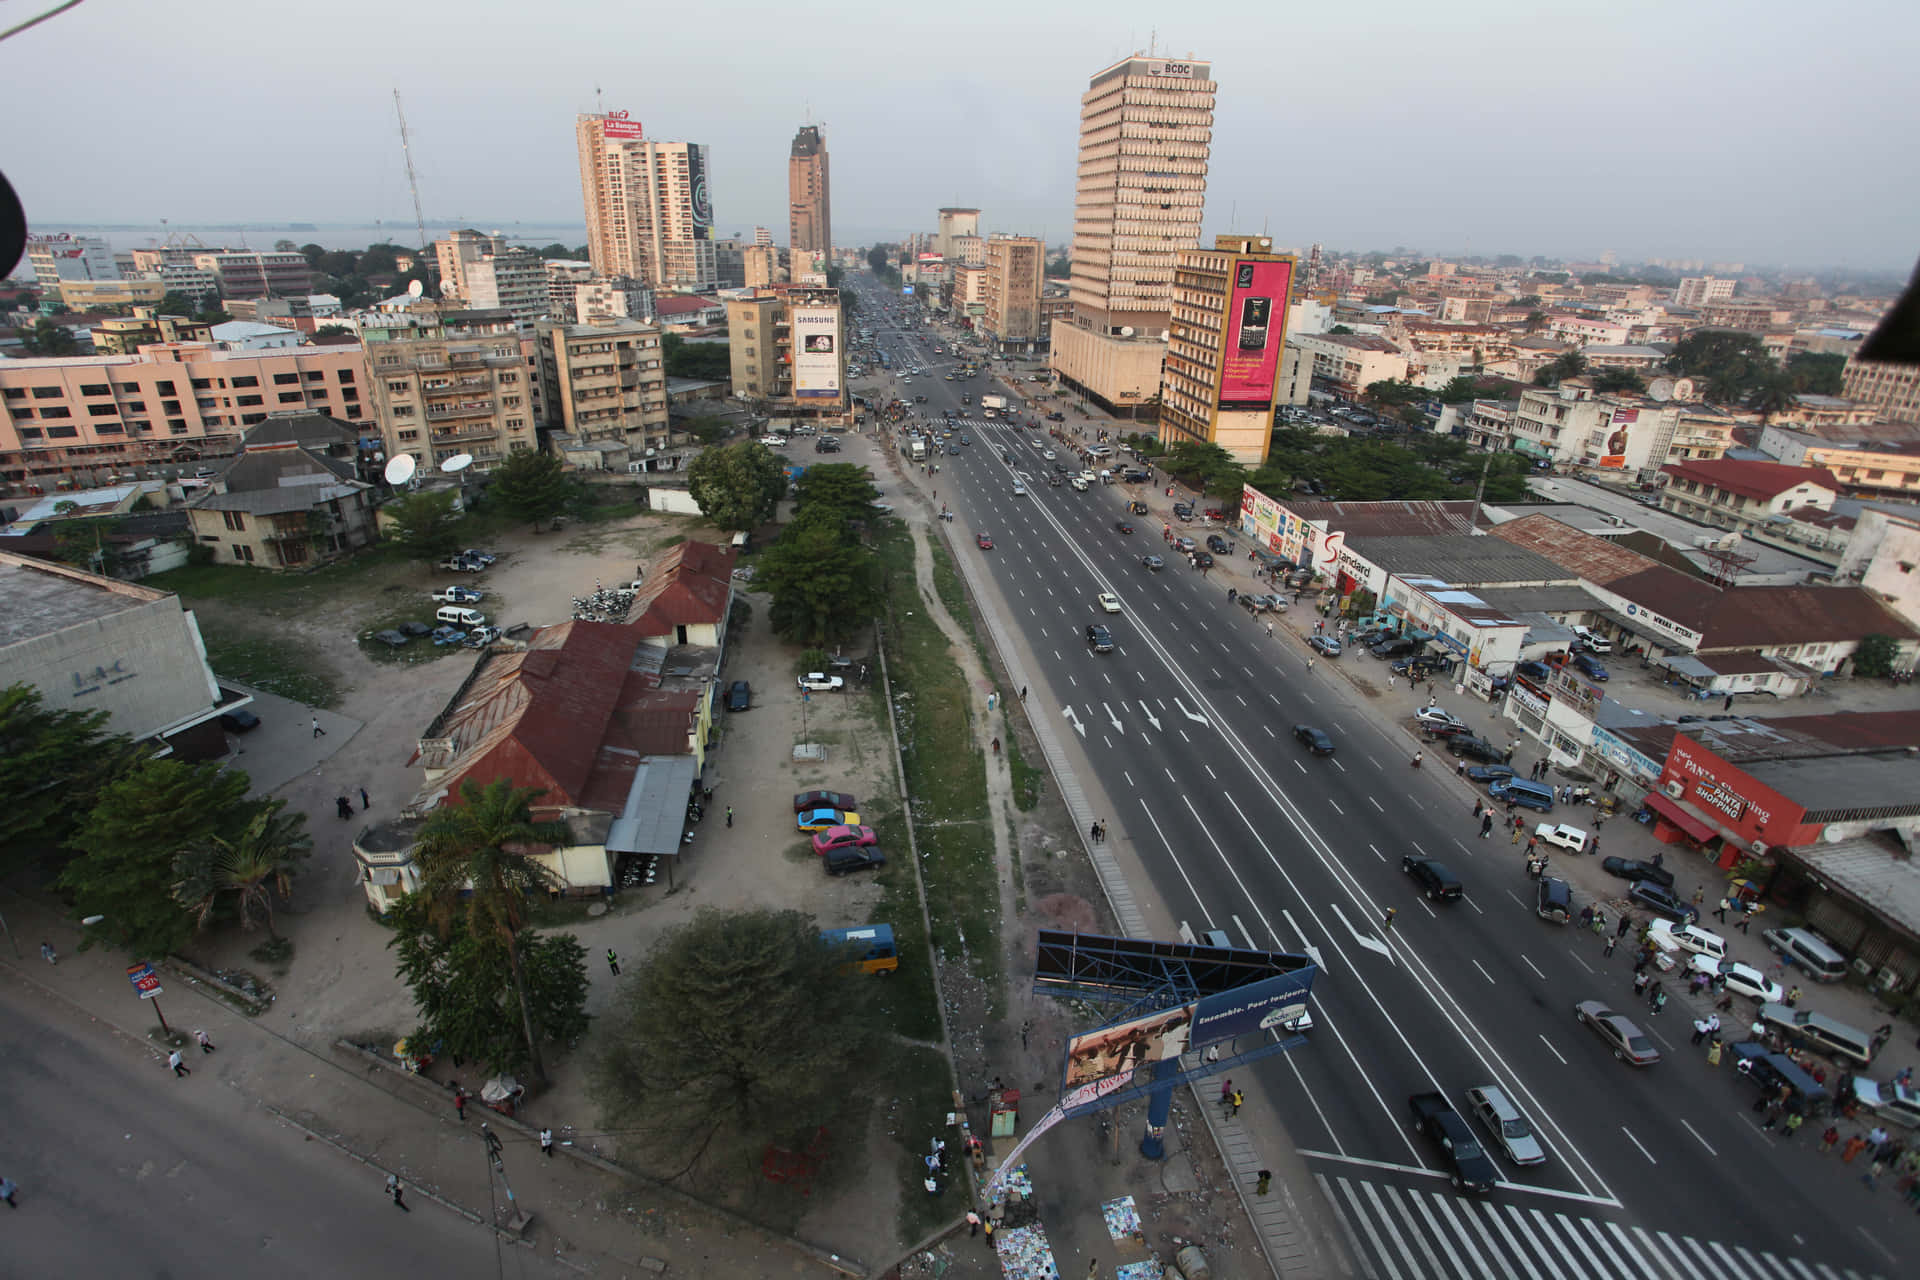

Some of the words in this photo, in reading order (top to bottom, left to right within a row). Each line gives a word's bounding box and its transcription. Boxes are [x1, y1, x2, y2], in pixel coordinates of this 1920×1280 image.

[1165, 63, 1190, 74] BCDC
[798, 316, 835, 324] SAMSUNG
[1320, 534, 1371, 578] Standard
[1696, 786, 1738, 818] SHOPPING
[1713, 787, 1741, 811] PANTA
